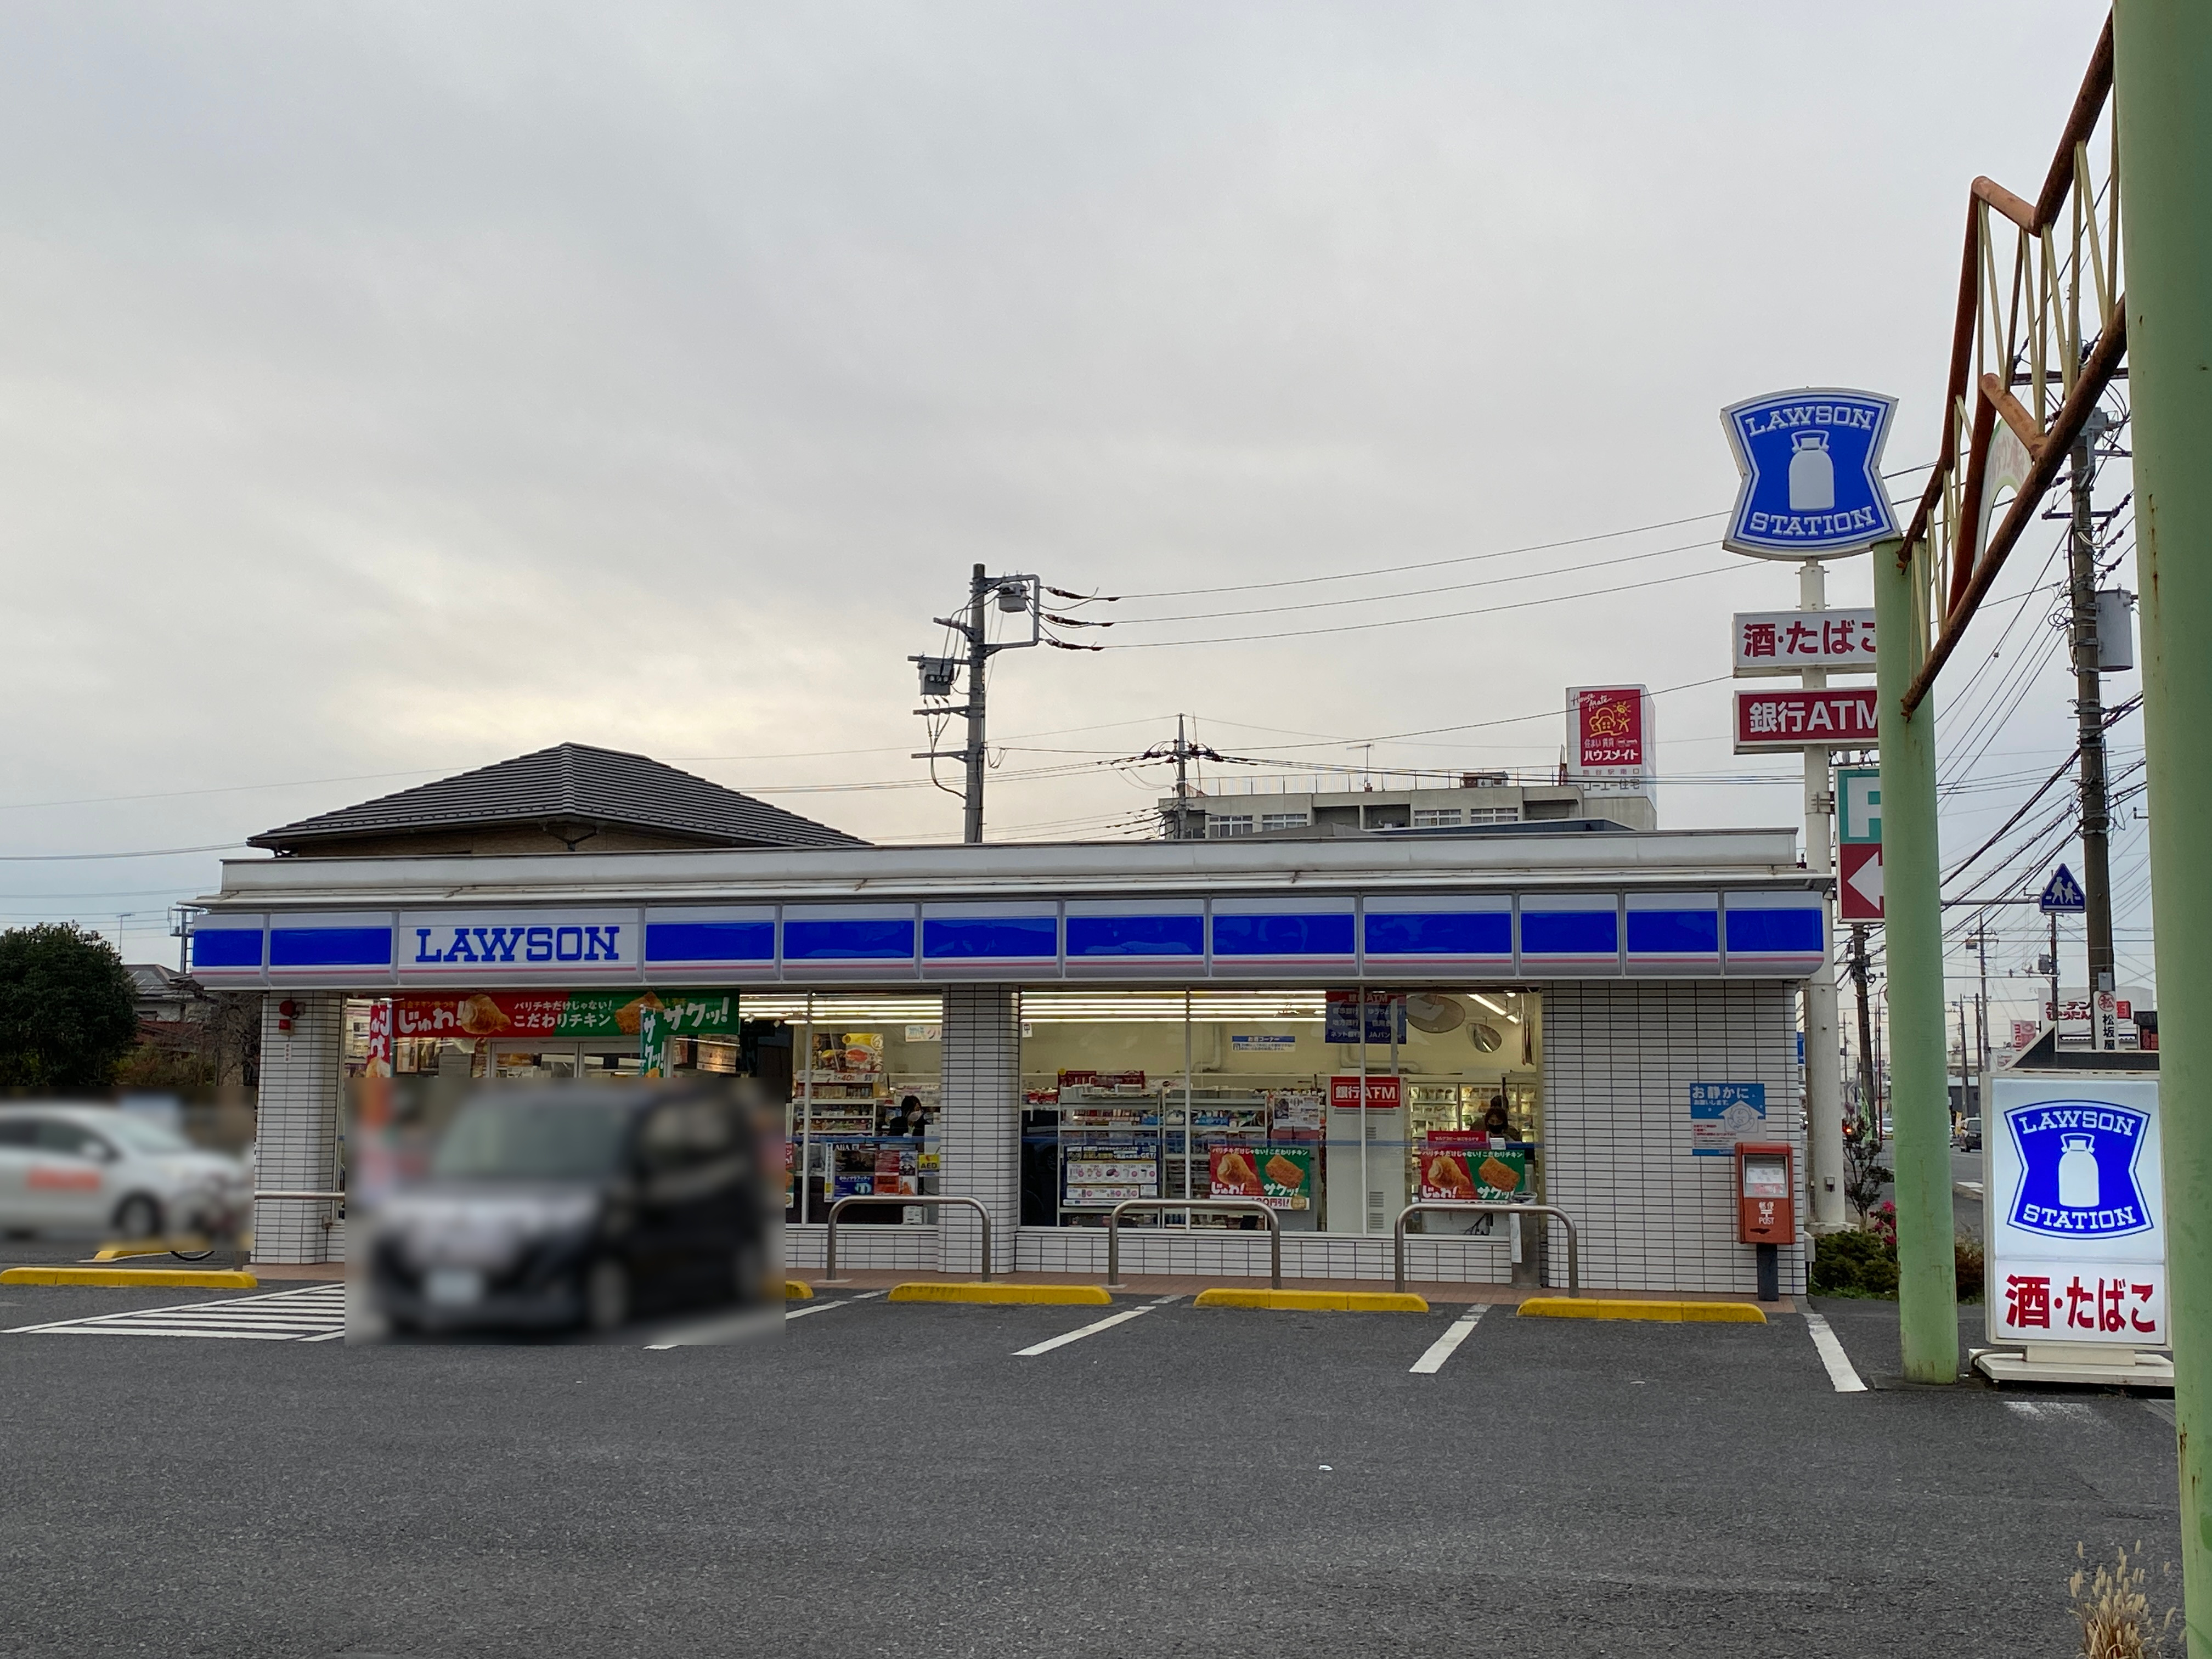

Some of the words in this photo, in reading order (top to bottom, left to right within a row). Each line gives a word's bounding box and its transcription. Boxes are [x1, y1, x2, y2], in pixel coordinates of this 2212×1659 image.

[1745, 405, 1875, 437] LAWSON
[1750, 506, 1876, 536] STATION
[1589, 695, 1612, 712] Mate
[1749, 700, 1878, 733] 銀行ATM
[1584, 749, 1639, 761] ハウスメイト
[415, 927, 620, 962] LAWSON
[514, 1013, 611, 1028] こだわりチキン
[2102, 1014, 2115, 1049] 松坂屋
[2013, 1024, 2022, 1051] meiji
[1692, 1086, 1750, 1099] お静かに
[2019, 1110, 2136, 1136] LAWSON
[1758, 1217, 1775, 1225] POST
[2023, 1204, 2136, 1230] STATION
[2005, 1274, 2157, 1333] 酒・たばこ
